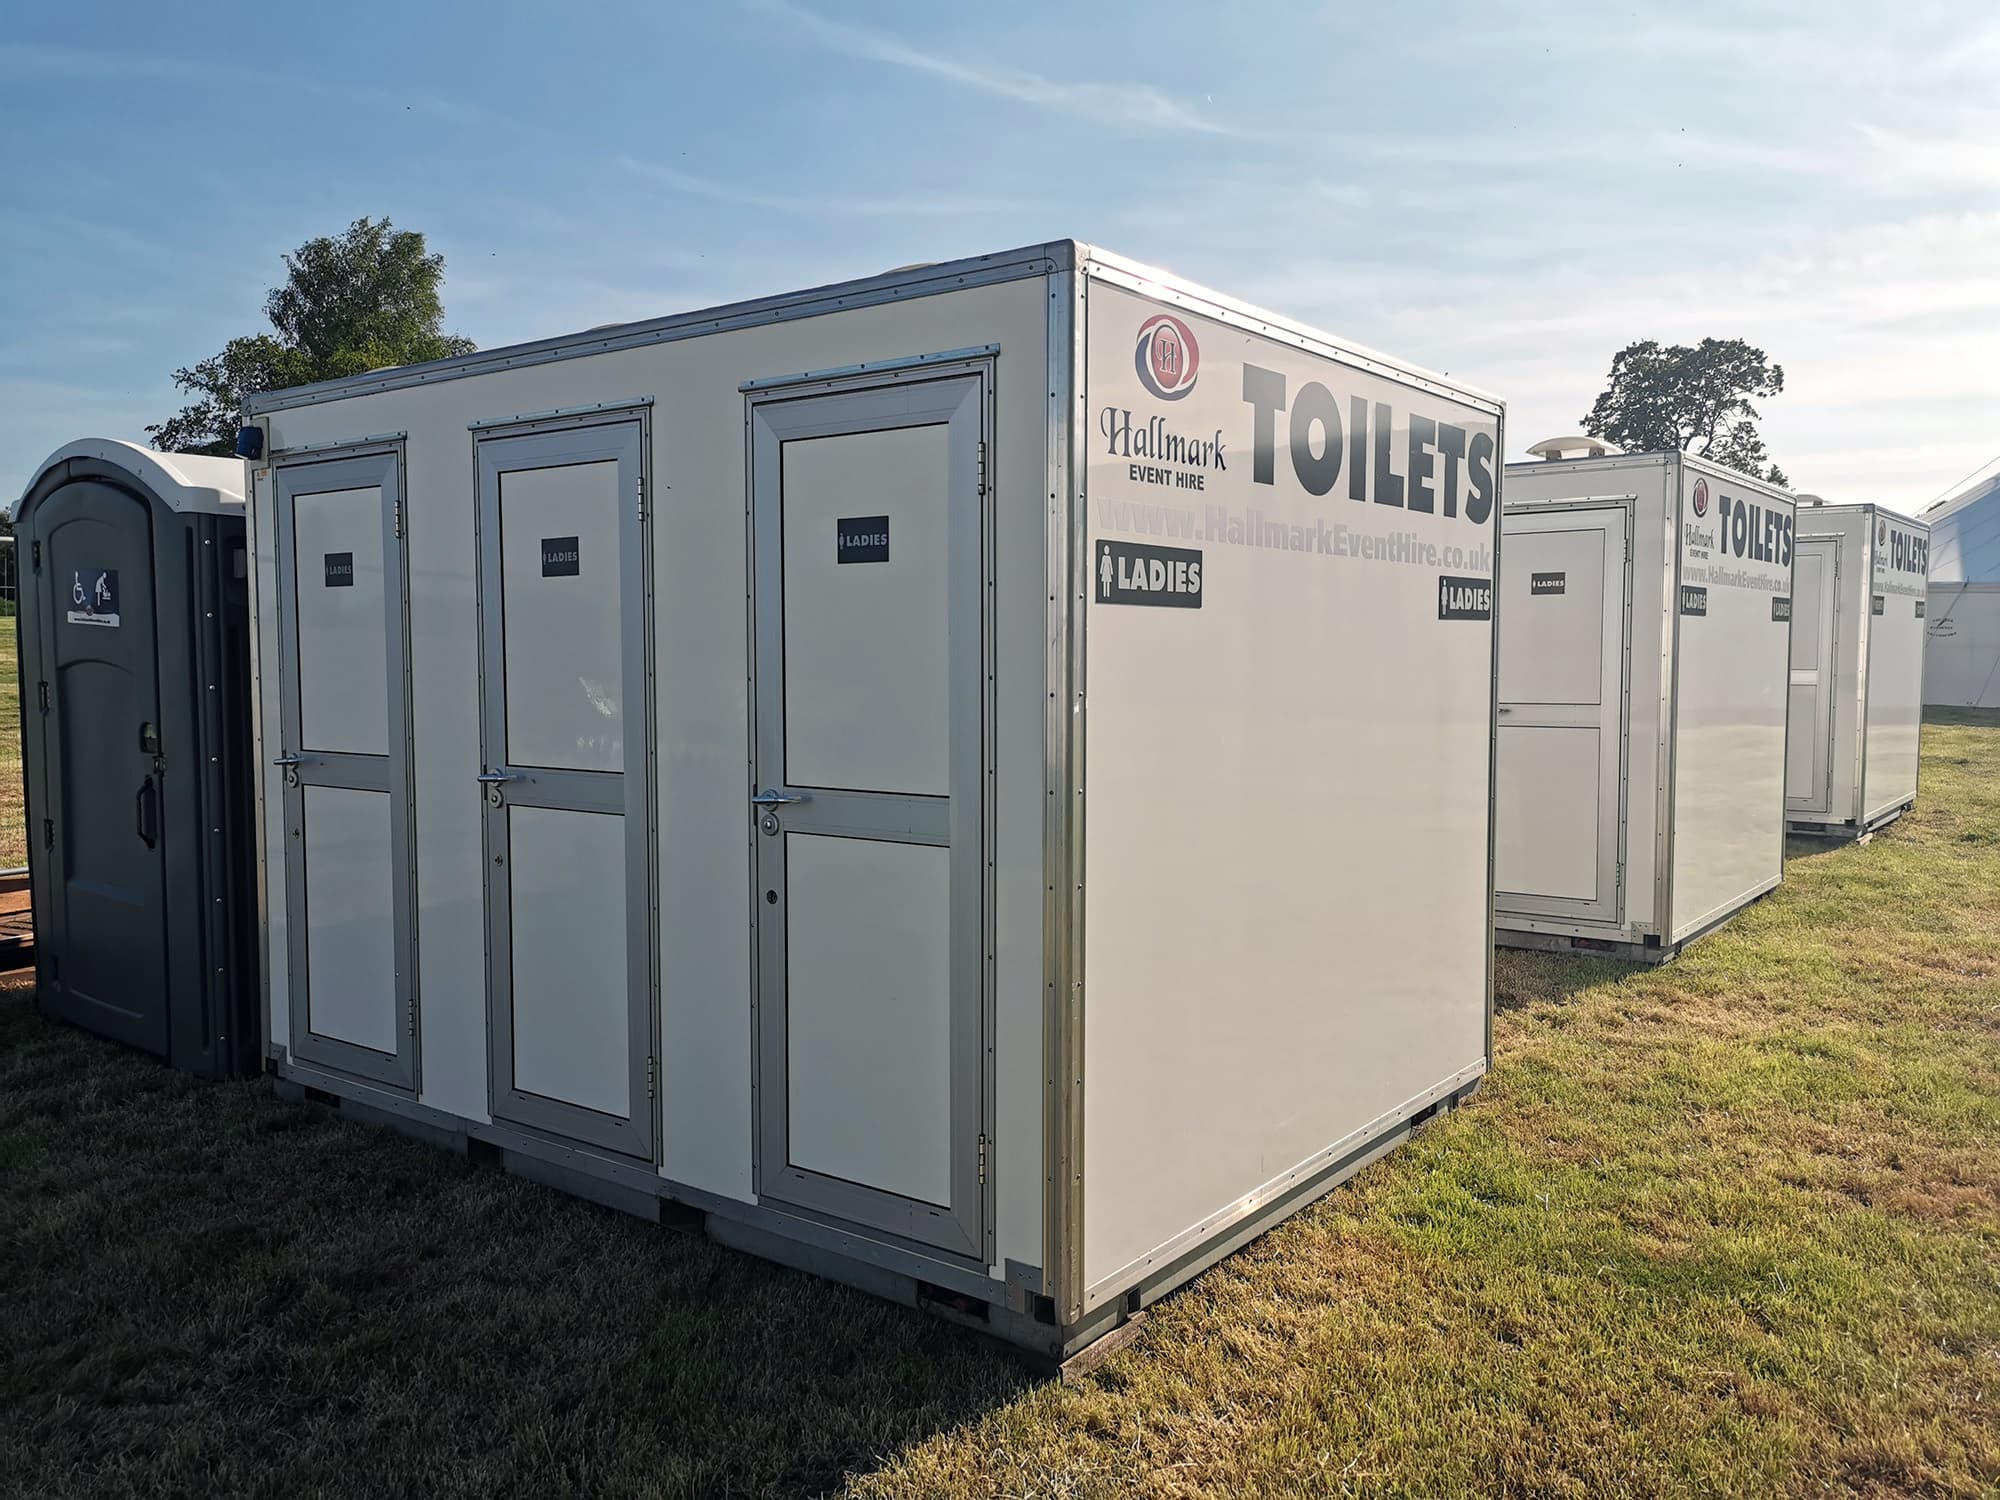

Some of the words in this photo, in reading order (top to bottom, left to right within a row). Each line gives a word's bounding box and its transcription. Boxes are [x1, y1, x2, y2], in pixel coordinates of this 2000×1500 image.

[1100, 406, 1227, 471] Hallmark
[1243, 362, 1495, 525] TOILETS
[1129, 464, 1172, 486] EVENT
[1175, 471, 1205, 491] HIRE
[846, 533, 888, 547] LADIES
[1097, 497, 1491, 572] www.HallmarkEventHire.co.uk
[1719, 494, 1792, 568] TOILETS
[547, 551, 577, 563] LADIES
[1890, 529, 1928, 576] TOILETS
[1118, 556, 1201, 594] LADIES
[1537, 580, 1564, 588] LADIES
[1450, 586, 1491, 612] LADIES
[1685, 592, 1706, 610] LADIES
